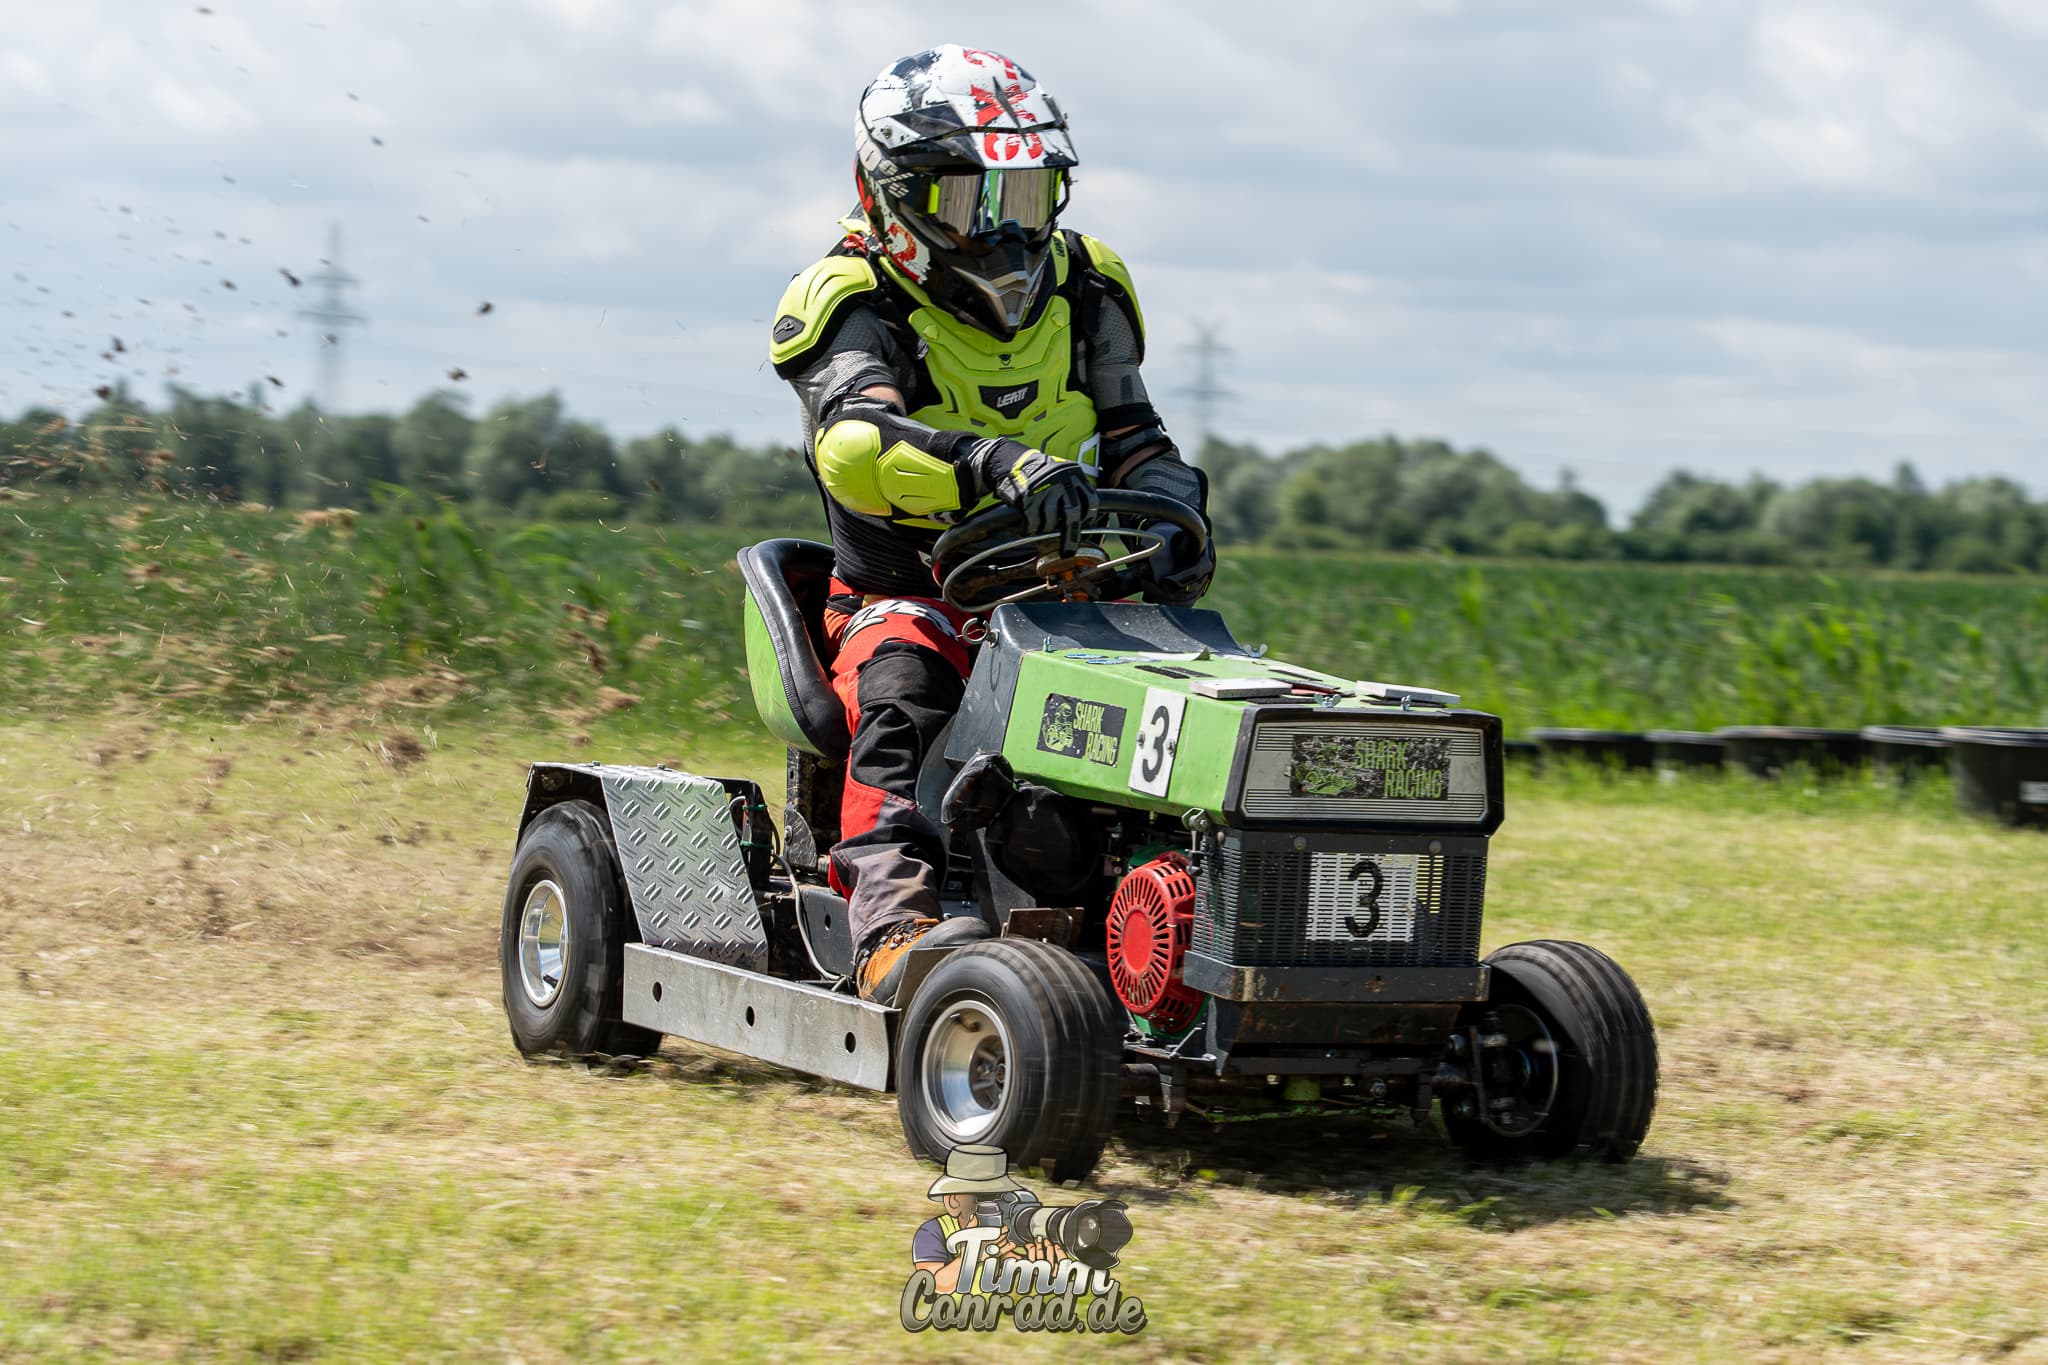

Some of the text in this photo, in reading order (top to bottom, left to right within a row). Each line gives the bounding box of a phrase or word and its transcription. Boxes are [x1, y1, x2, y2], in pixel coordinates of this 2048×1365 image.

[996, 387, 1028, 408] LEATT
[1073, 701, 1105, 733] SHARK
[1085, 731, 1118, 765] RACING
[1142, 705, 1170, 783] 3
[1354, 740, 1409, 769] SHARK
[1383, 769, 1443, 799] RACING
[1344, 860, 1384, 938] 3
